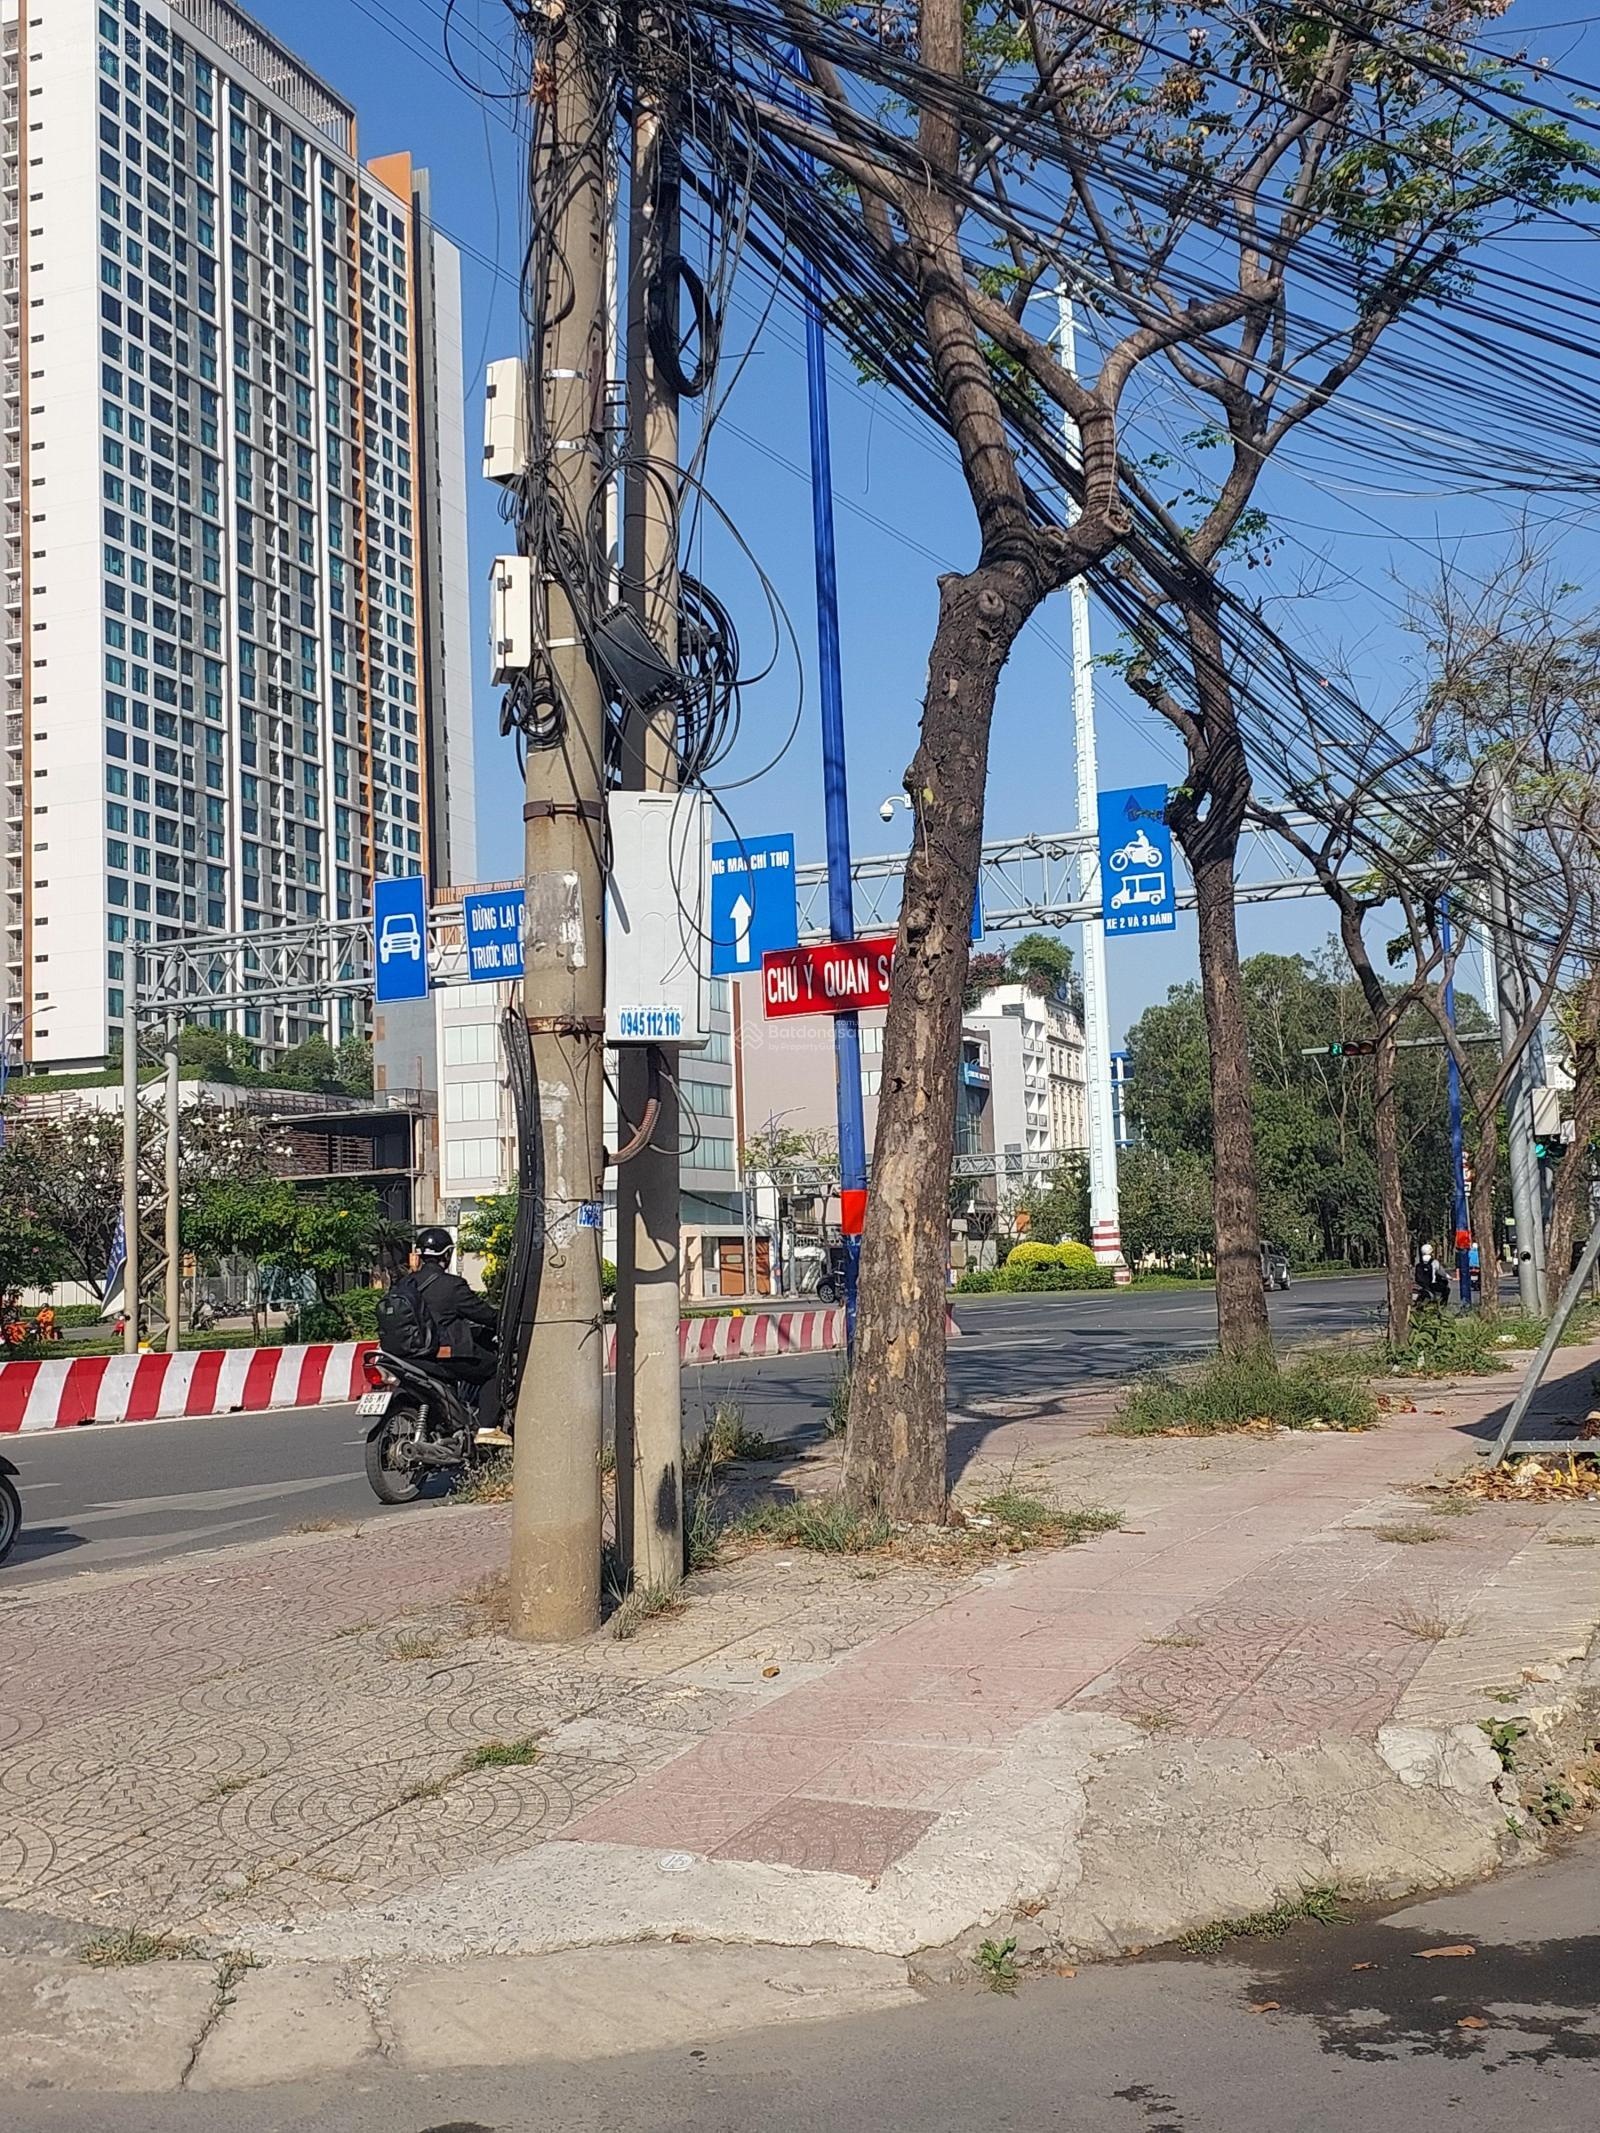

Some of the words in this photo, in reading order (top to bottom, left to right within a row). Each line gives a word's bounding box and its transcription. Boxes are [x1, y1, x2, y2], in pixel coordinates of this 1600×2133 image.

[750, 851, 767, 870] CHÍ
[770, 850, 790, 869] THỌ
[499, 904, 516, 932] LẠI
[1106, 917, 1118, 930] XE
[1119, 916, 1126, 929] 2
[1127, 913, 1140, 928] VÀ
[1141, 914, 1148, 927] 3
[1149, 911, 1173, 926] BÁNH
[471, 939, 501, 970] TRƯỚC
[502, 942, 518, 967] KHI
[767, 955, 798, 1004] CHÚ
[803, 953, 814, 1000] Ý
[823, 957, 869, 998] QUAN
